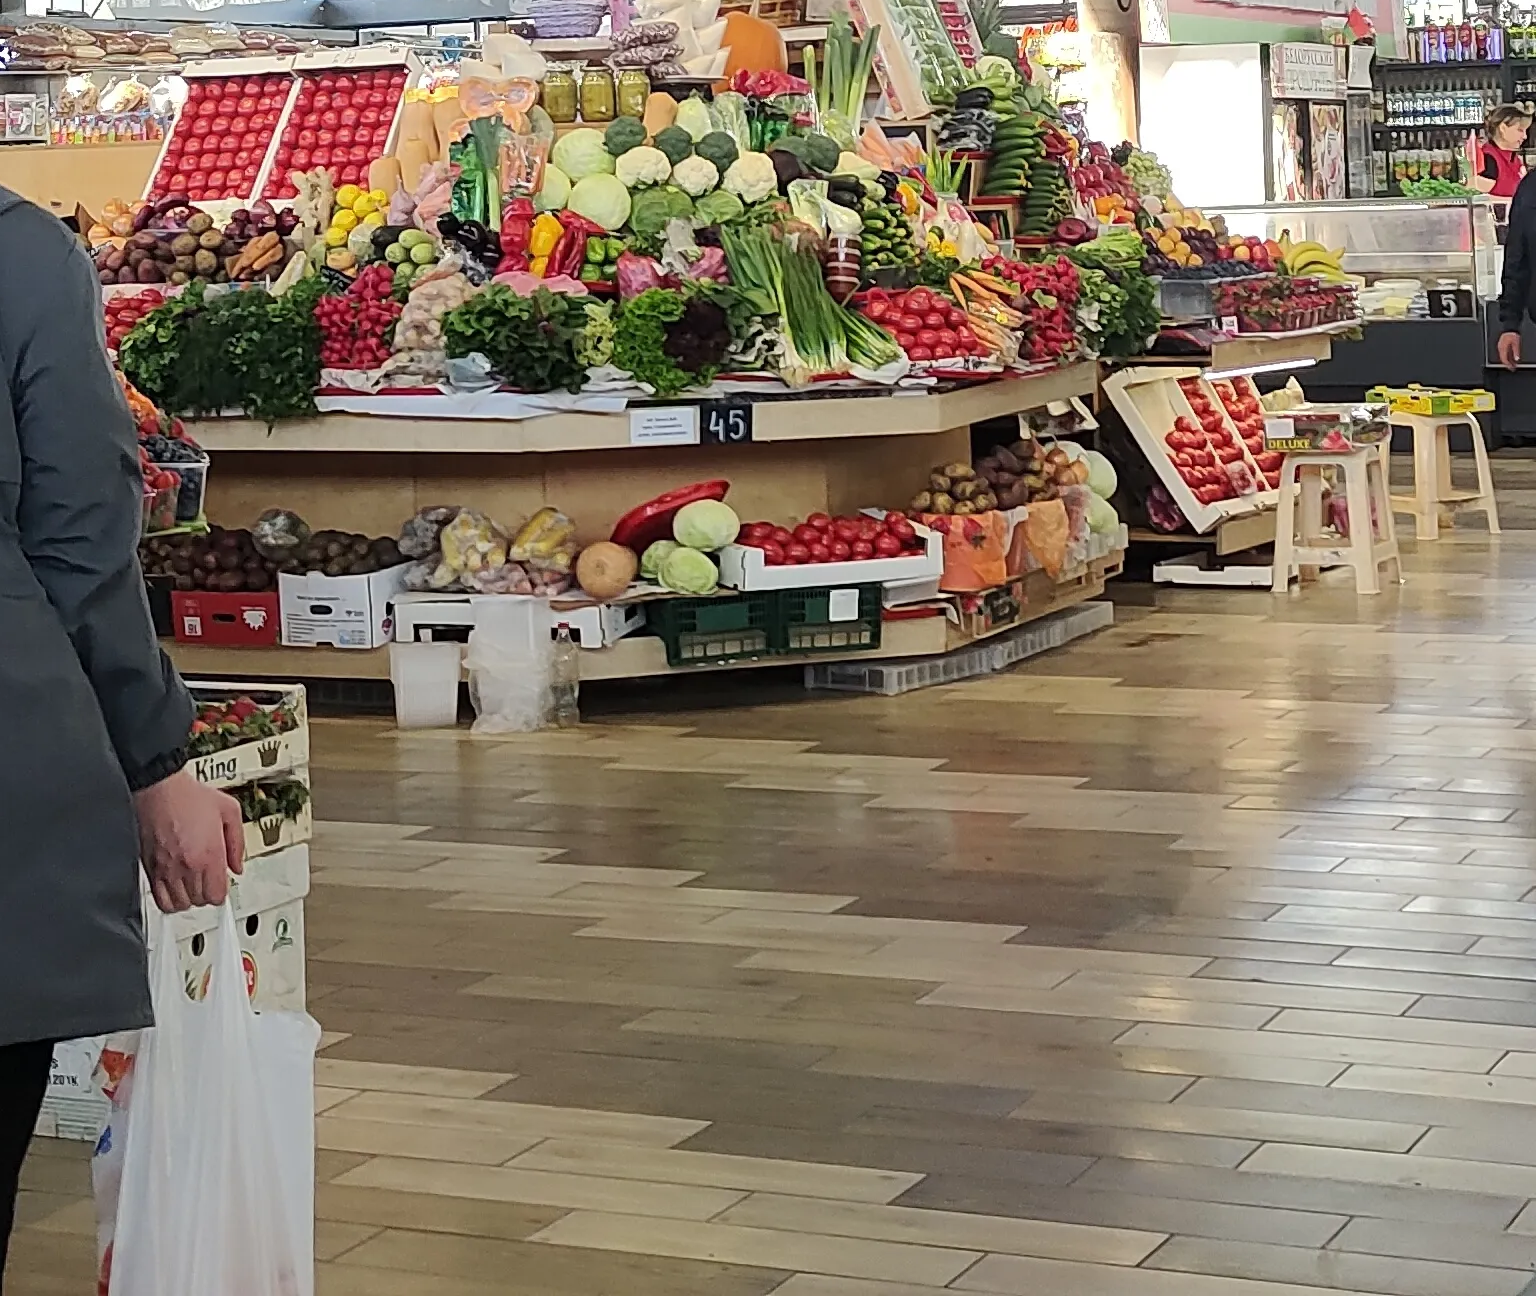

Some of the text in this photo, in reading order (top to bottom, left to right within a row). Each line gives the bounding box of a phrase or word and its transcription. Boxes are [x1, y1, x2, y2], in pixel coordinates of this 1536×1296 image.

[1440, 293, 1458, 317] 5
[708, 409, 746, 442] 45
[1268, 438, 1311, 450] DELUXE
[194, 757, 238, 783] King
